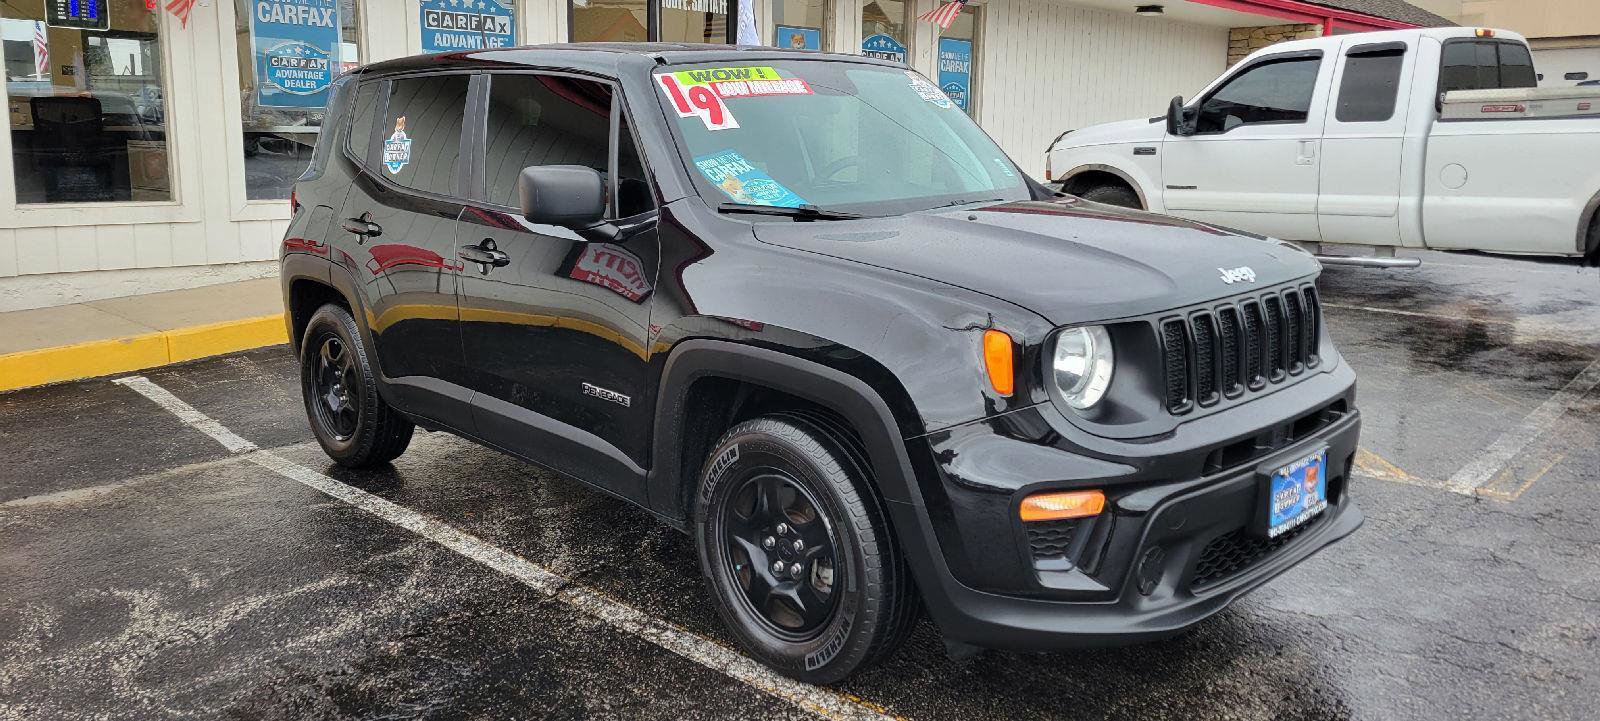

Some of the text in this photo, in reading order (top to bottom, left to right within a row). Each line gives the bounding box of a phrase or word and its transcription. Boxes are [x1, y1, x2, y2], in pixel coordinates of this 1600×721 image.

[257, 2, 334, 28] CARFAX
[426, 11, 509, 34] CARFAX
[270, 56, 328, 70] CARFAX
[941, 60, 969, 74] CARFAX
[274, 69, 325, 80] ADVANTAGE
[284, 79, 317, 89] DEALER
[689, 71, 751, 83] WOW
[704, 159, 756, 182] CARFAX
[1216, 266, 1256, 284] Jeep
[582, 382, 631, 408] RENEGADE
[701, 446, 738, 502] MICHELIN
[806, 613, 851, 669] MICHELIN
